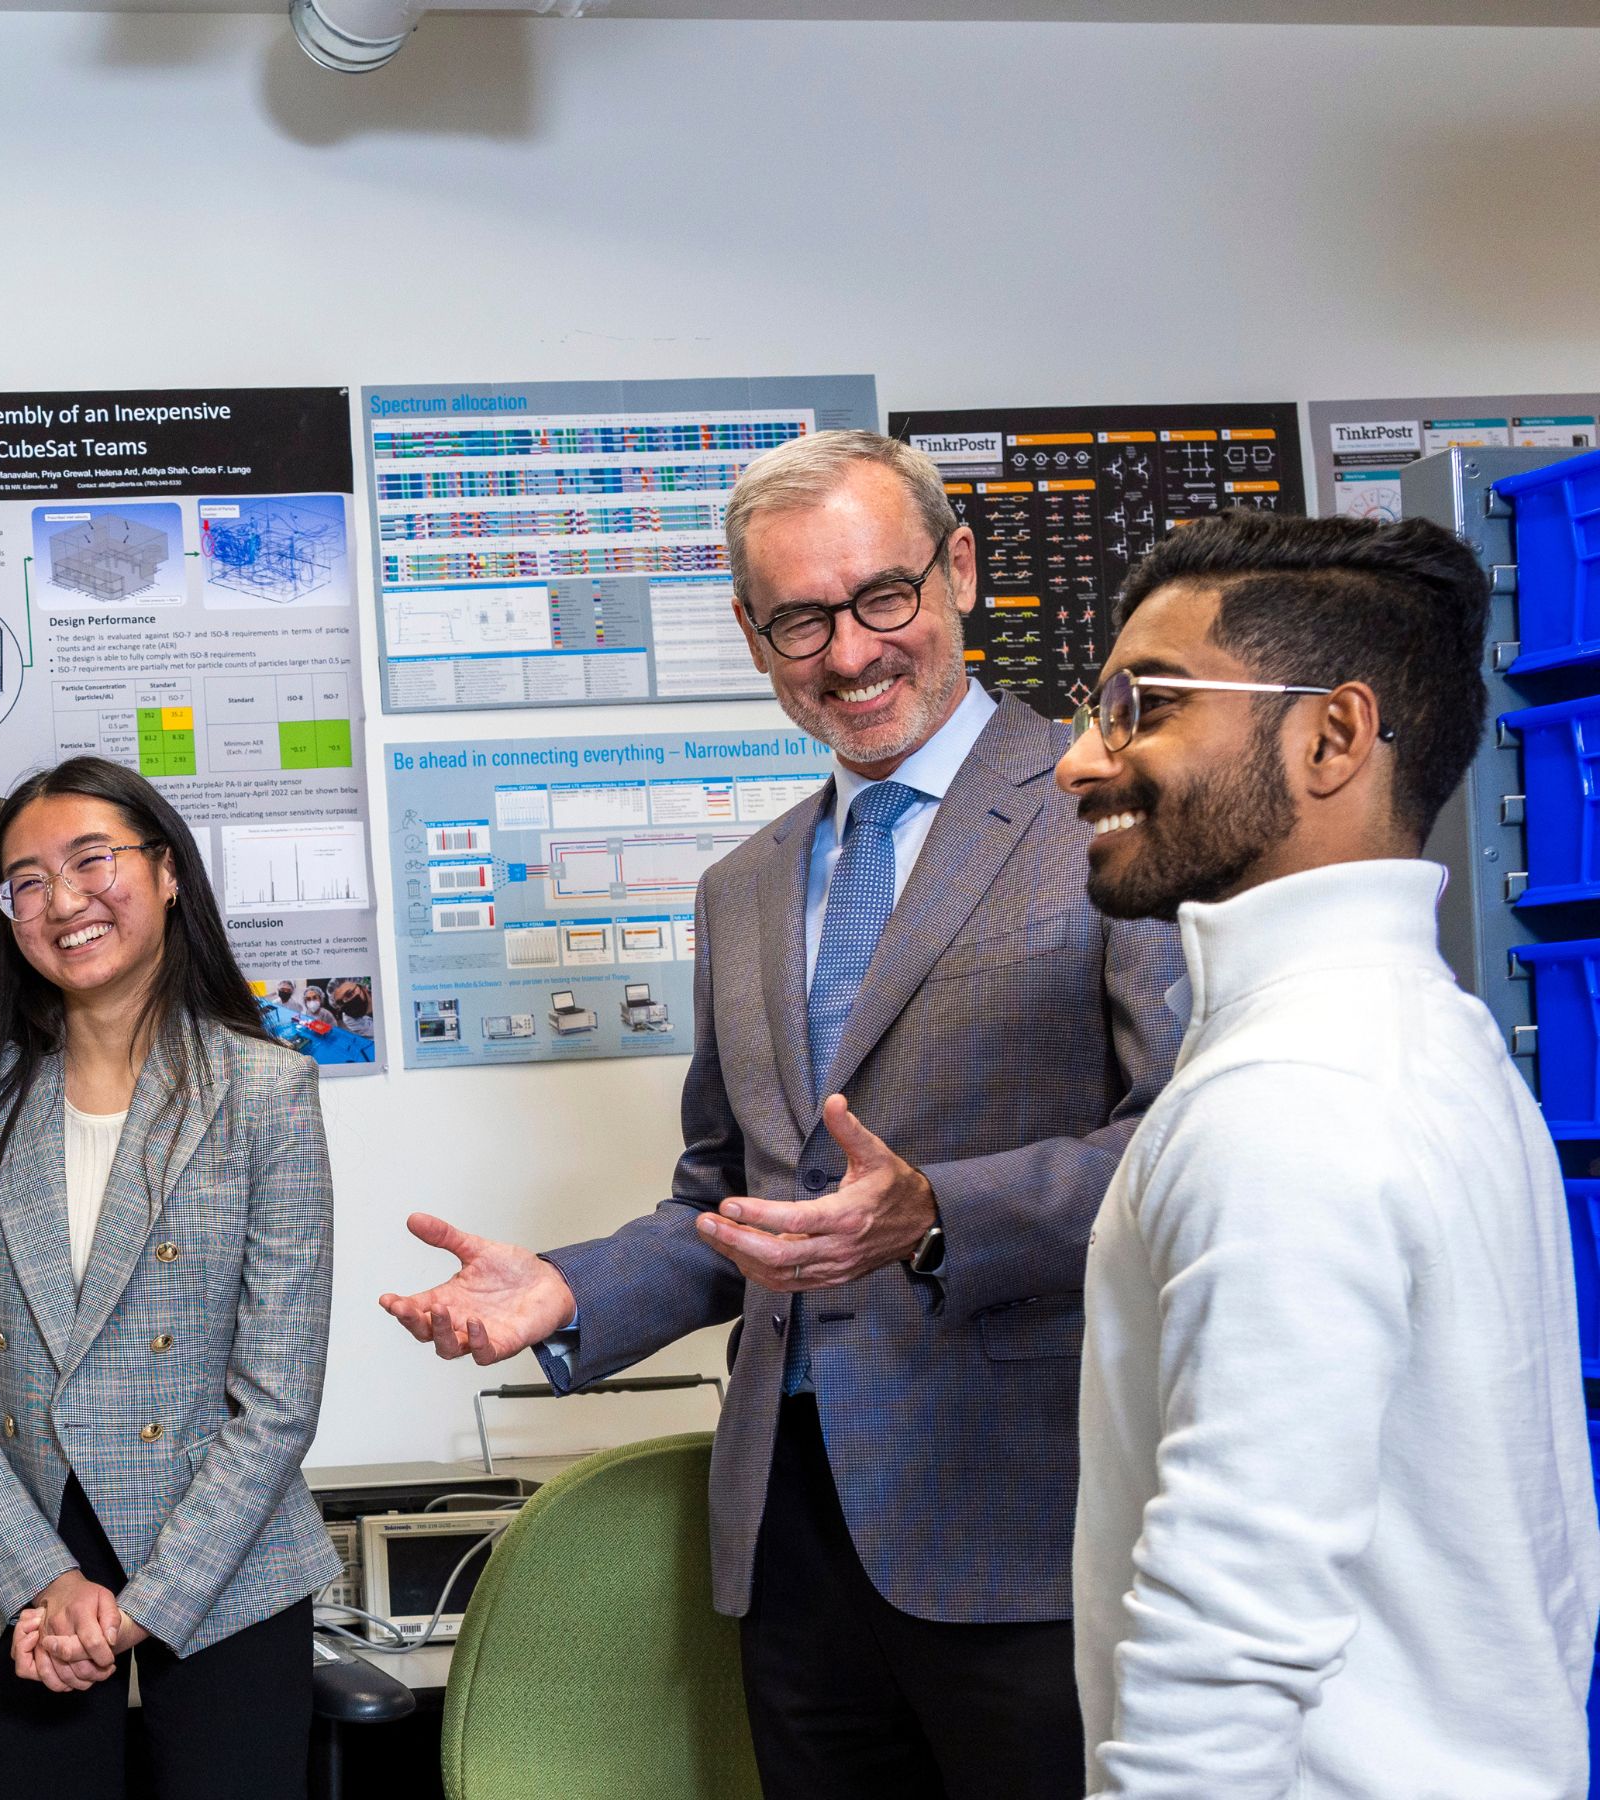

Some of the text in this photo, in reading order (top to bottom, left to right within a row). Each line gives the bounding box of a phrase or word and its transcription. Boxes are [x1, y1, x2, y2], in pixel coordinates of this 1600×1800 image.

[370, 393, 527, 416] Spectrum allocation
[58, 405, 79, 423] of
[84, 409, 108, 423] an
[114, 402, 230, 425] Inexpensive
[1336, 426, 1412, 440] TinkrPostr
[81, 438, 147, 457] Teams
[916, 437, 996, 451] TinkrPostr
[41, 469, 61, 480] Priya
[62, 468, 94, 478] Grewal,
[94, 468, 122, 477] Helena
[123, 467, 141, 477] Ard,
[167, 466, 191, 476] Shah,
[191, 466, 216, 475] Carlos
[217, 466, 226, 474] F.
[226, 465, 251, 476] Lange
[49, 614, 155, 628] Design Performance
[71, 654, 95, 664] design
[129, 653, 144, 662] fully
[145, 653, 171, 662] comply
[209, 651, 256, 661] requirements
[393, 753, 413, 770] Be
[419, 750, 467, 768] ahead
[472, 750, 486, 766] in
[491, 746, 578, 770] connecting
[583, 742, 664, 766] everything
[684, 738, 779, 758] Narrowband
[784, 737, 806, 754] IoT
[191, 780, 223, 790] PurpleAir
[253, 778, 278, 787] quality
[226, 920, 283, 929] Conclusion
[259, 950, 287, 958] operate
[323, 946, 368, 955] requirements
[251, 960, 280, 969] majority
